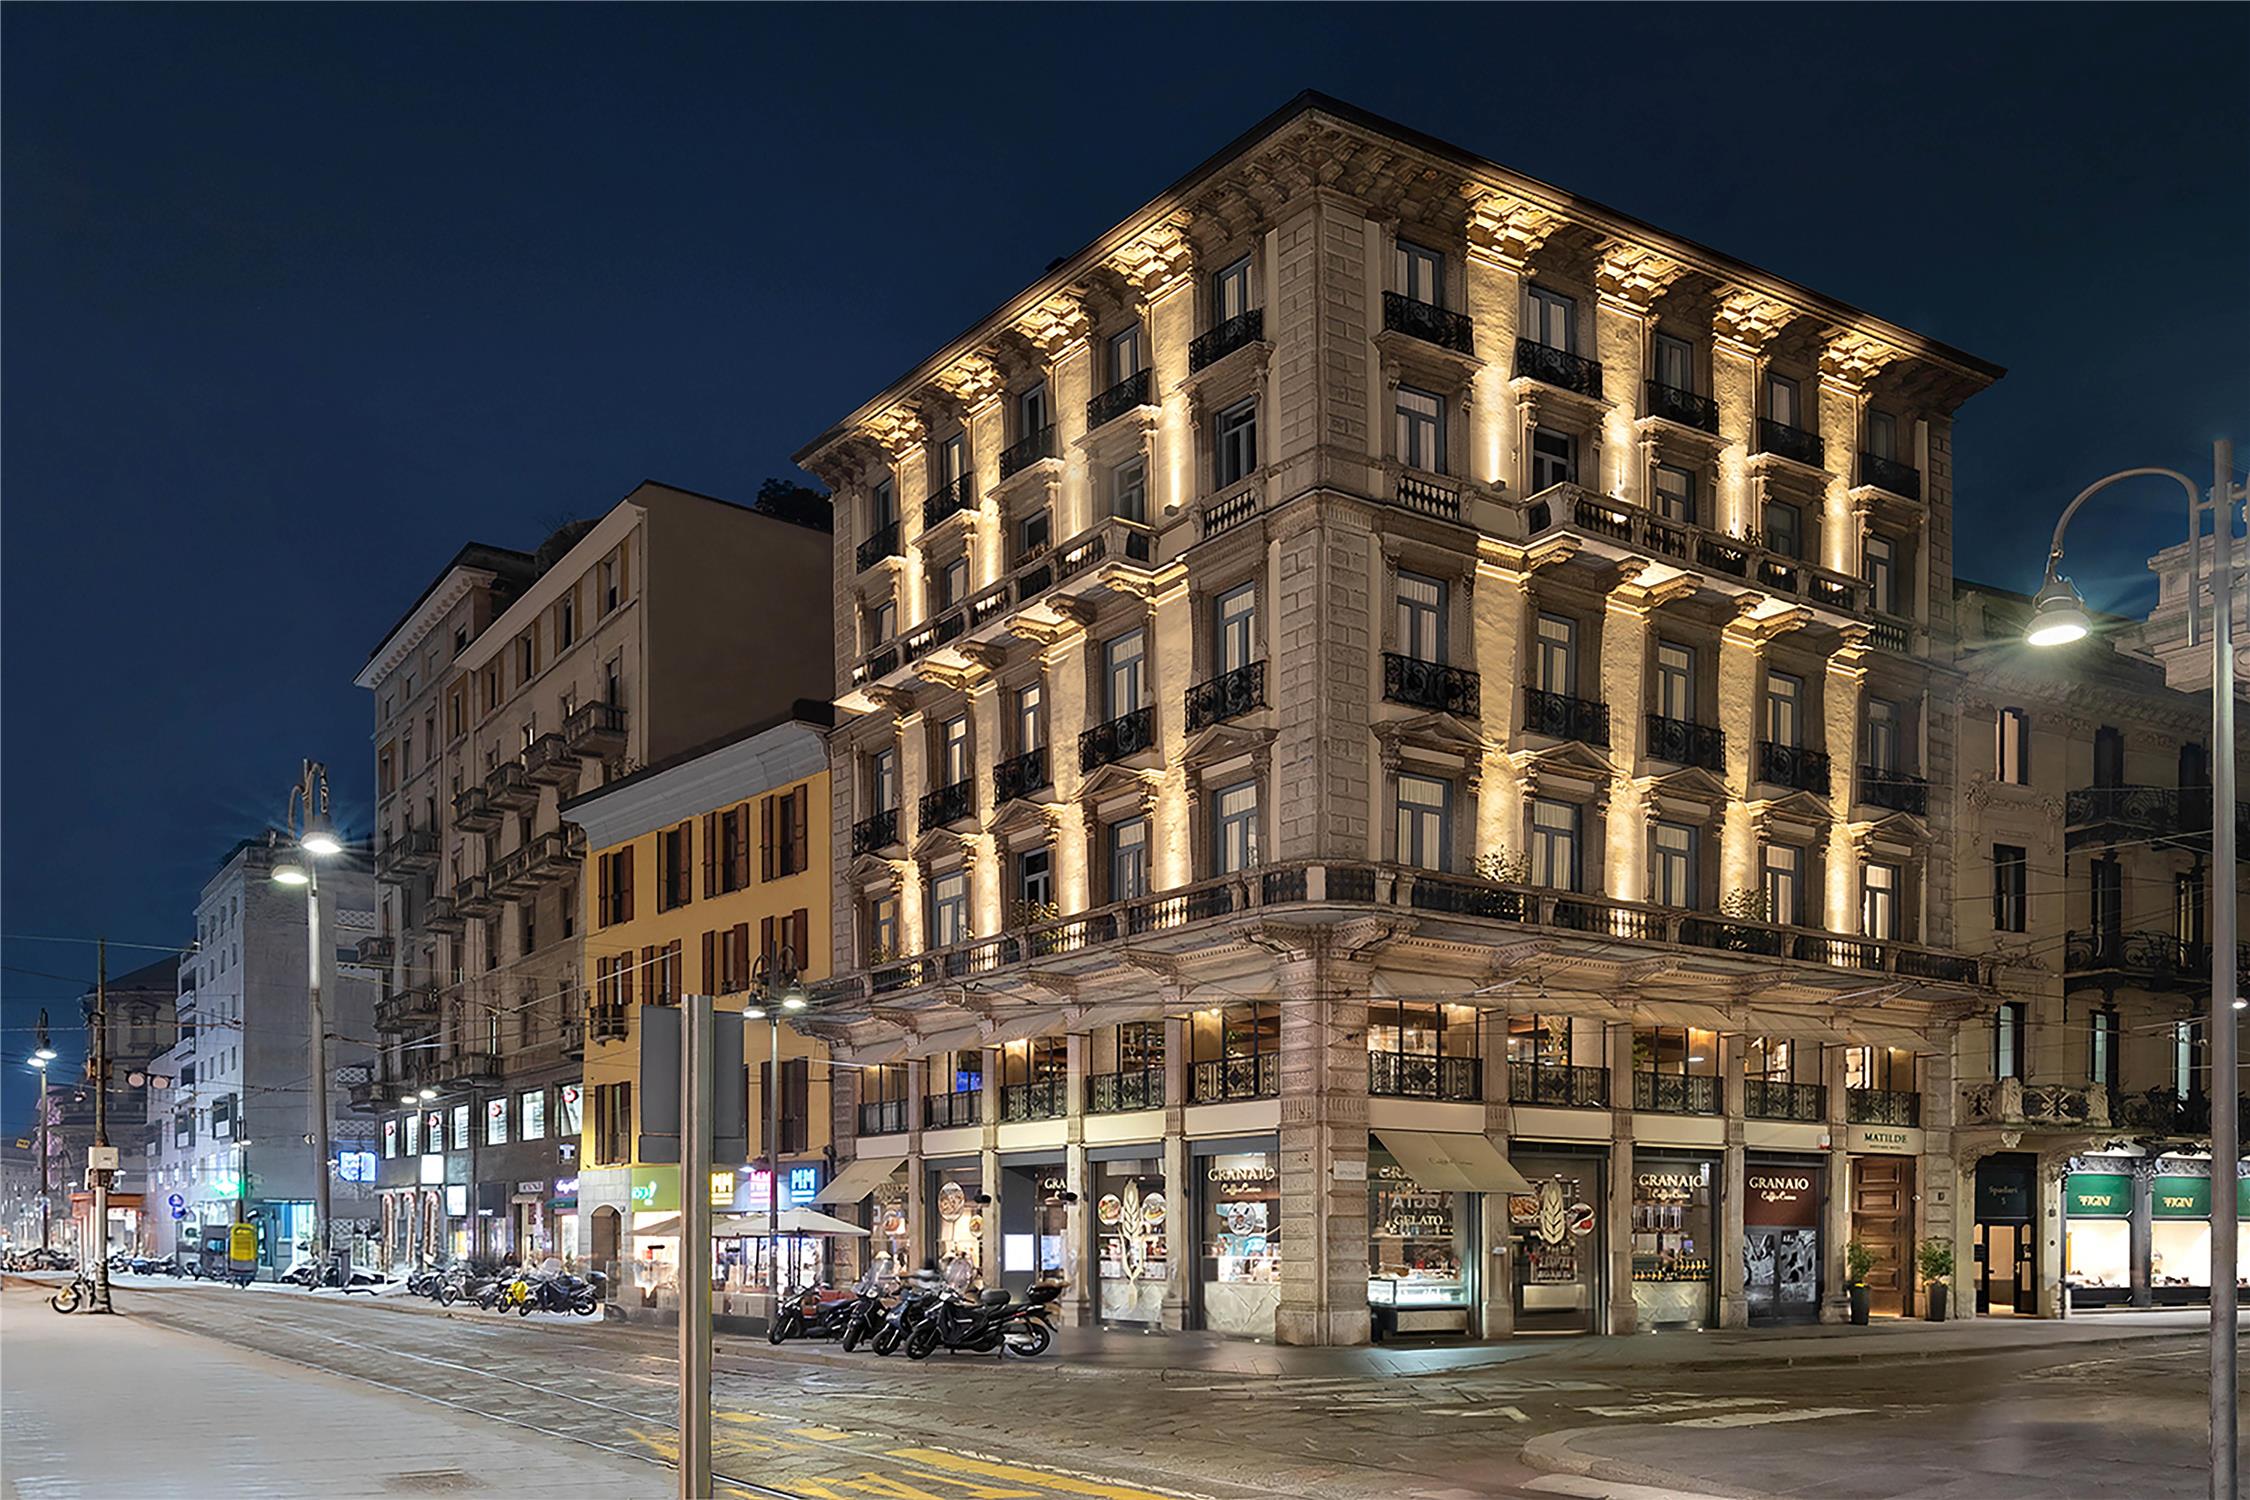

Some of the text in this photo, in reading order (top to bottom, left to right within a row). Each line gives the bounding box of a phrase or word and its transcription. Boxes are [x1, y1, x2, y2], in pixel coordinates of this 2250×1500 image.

[1864, 1132, 1909, 1144] MATILDE
[1207, 1166, 1276, 1182] GRANAIO
[1638, 1173, 1704, 1188] GRANAIO
[1748, 1176, 1810, 1190] GRANAIO
[1394, 1214, 1444, 1226] GELATO
